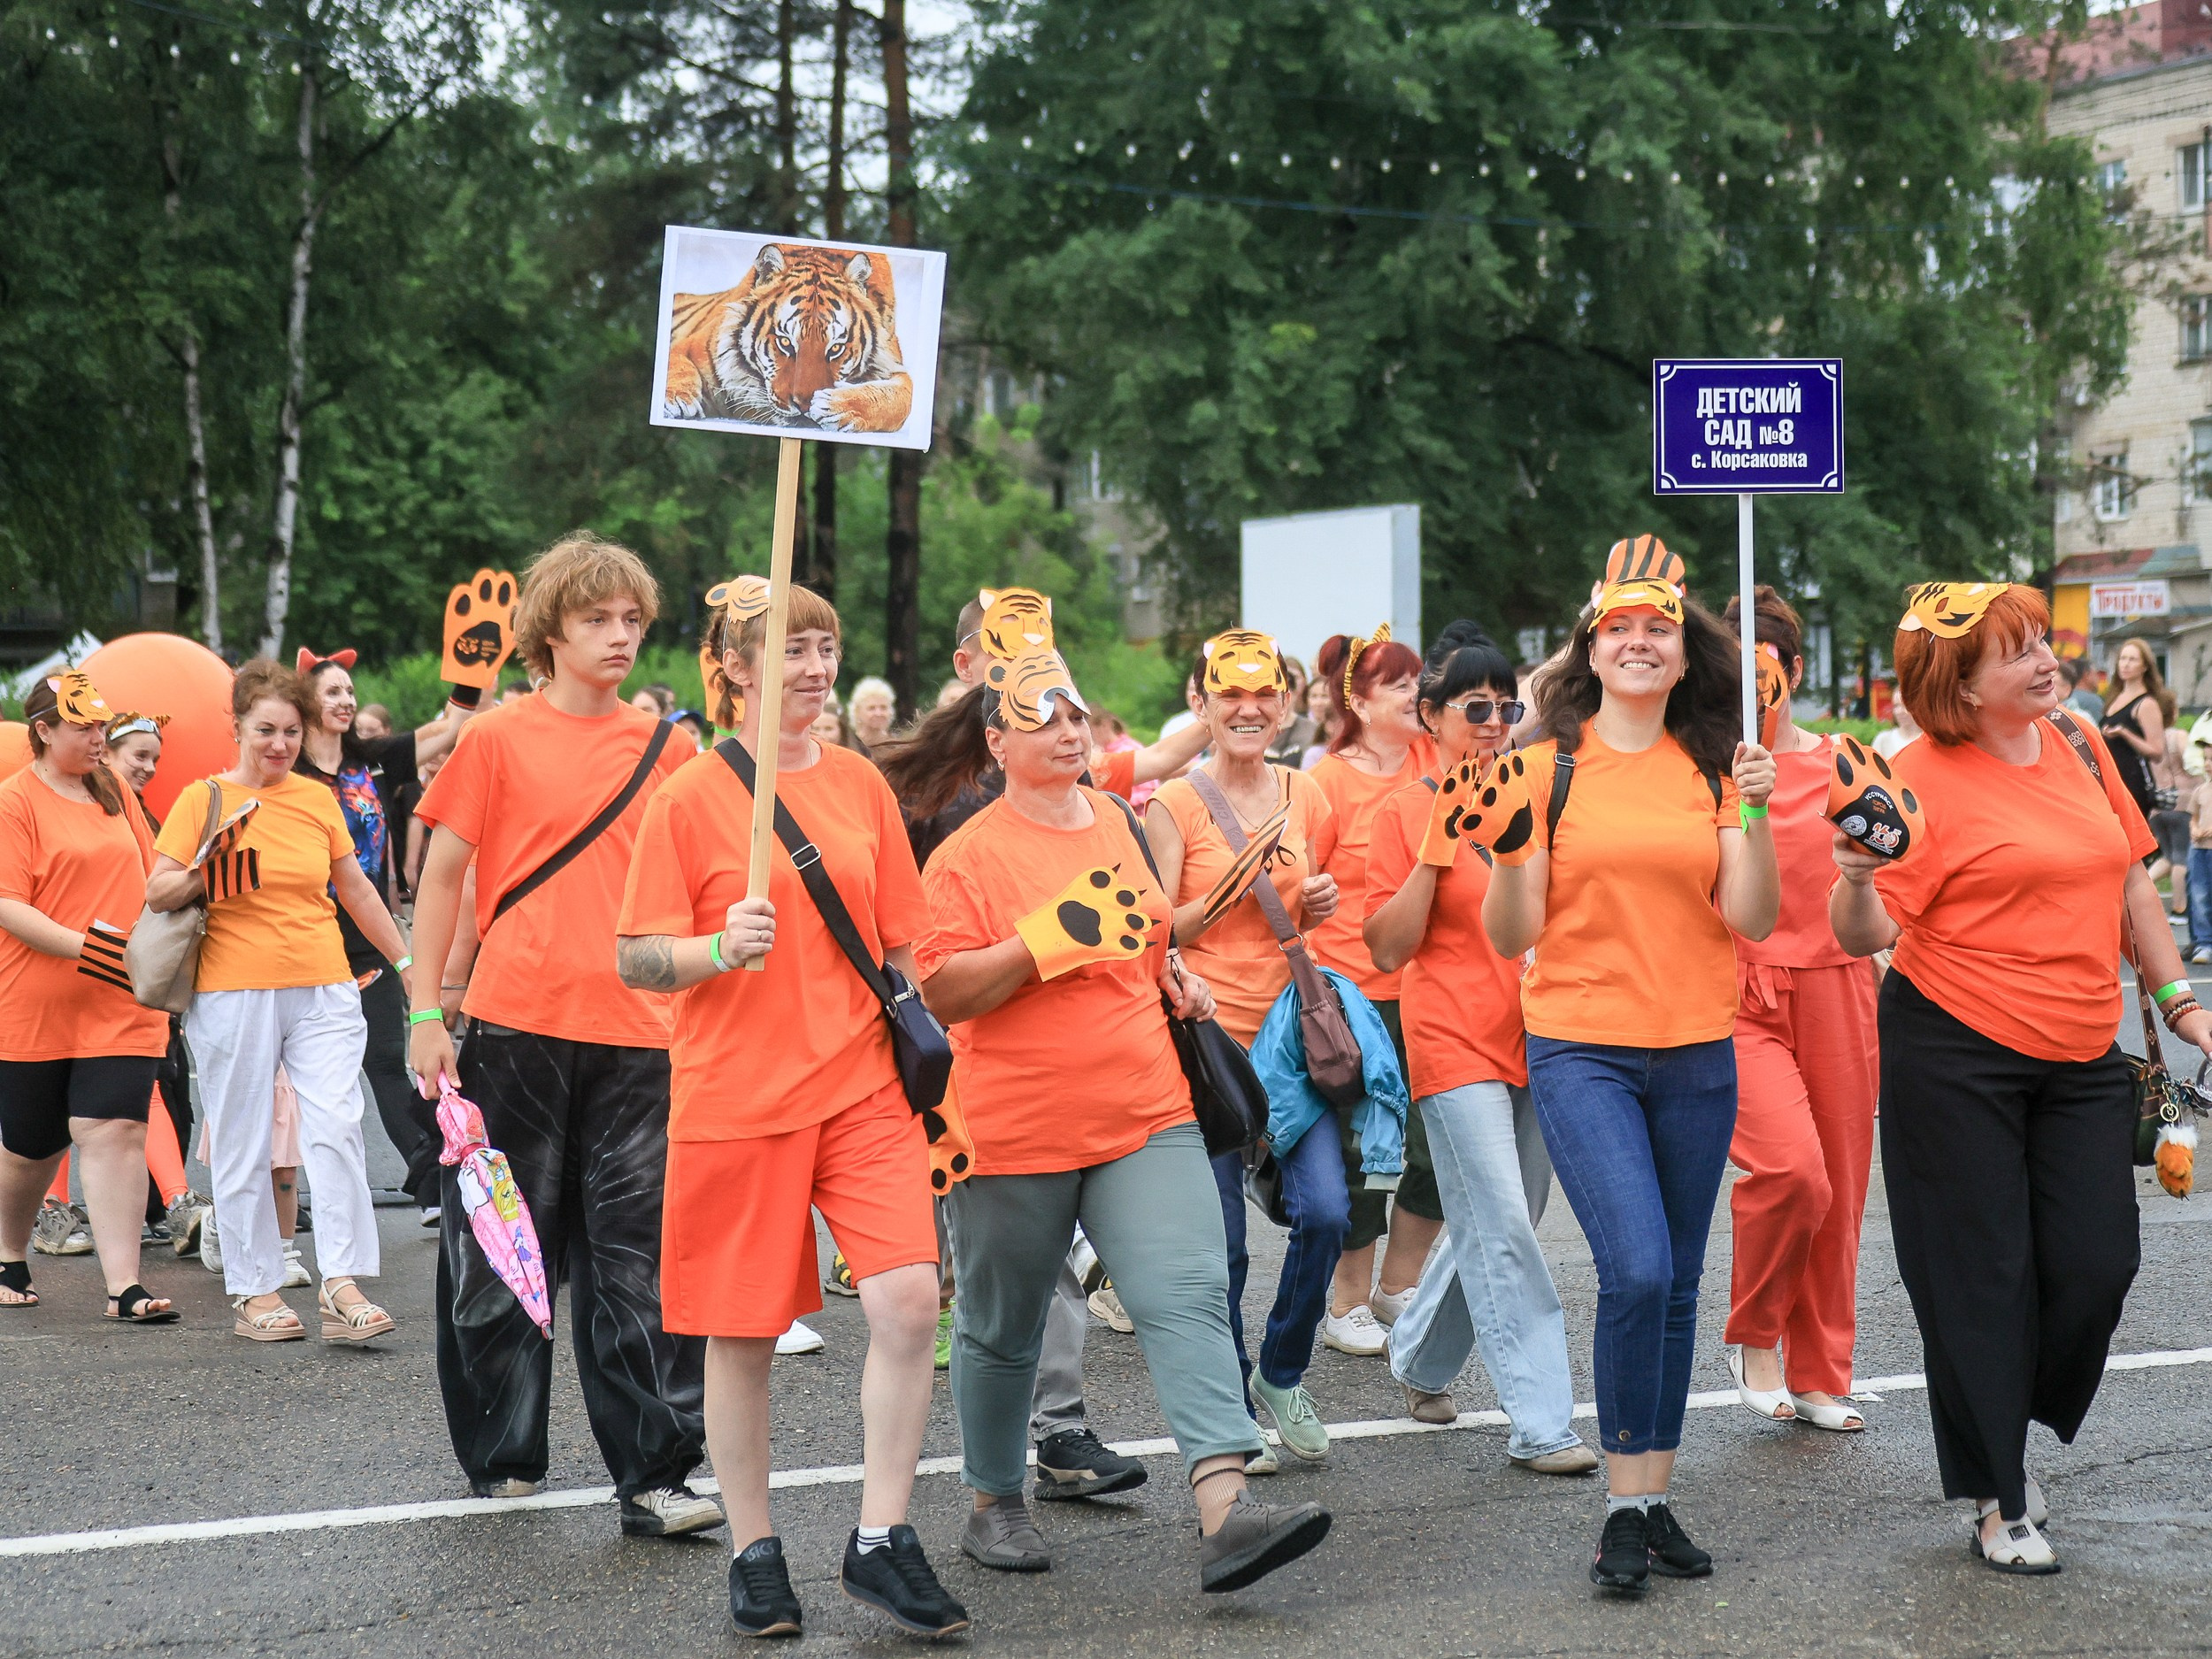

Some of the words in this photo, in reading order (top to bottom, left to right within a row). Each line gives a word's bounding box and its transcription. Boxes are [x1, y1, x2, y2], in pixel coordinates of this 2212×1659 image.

[1696, 381, 1801, 419] ДЕТСКИЙ
[1704, 419, 1753, 449] САД
[1759, 419, 1794, 445] №8
[1691, 454, 1707, 469] с.
[1711, 450, 1808, 471] Корсаковка
[1864, 791, 1893, 810] УССУРИЙСК
